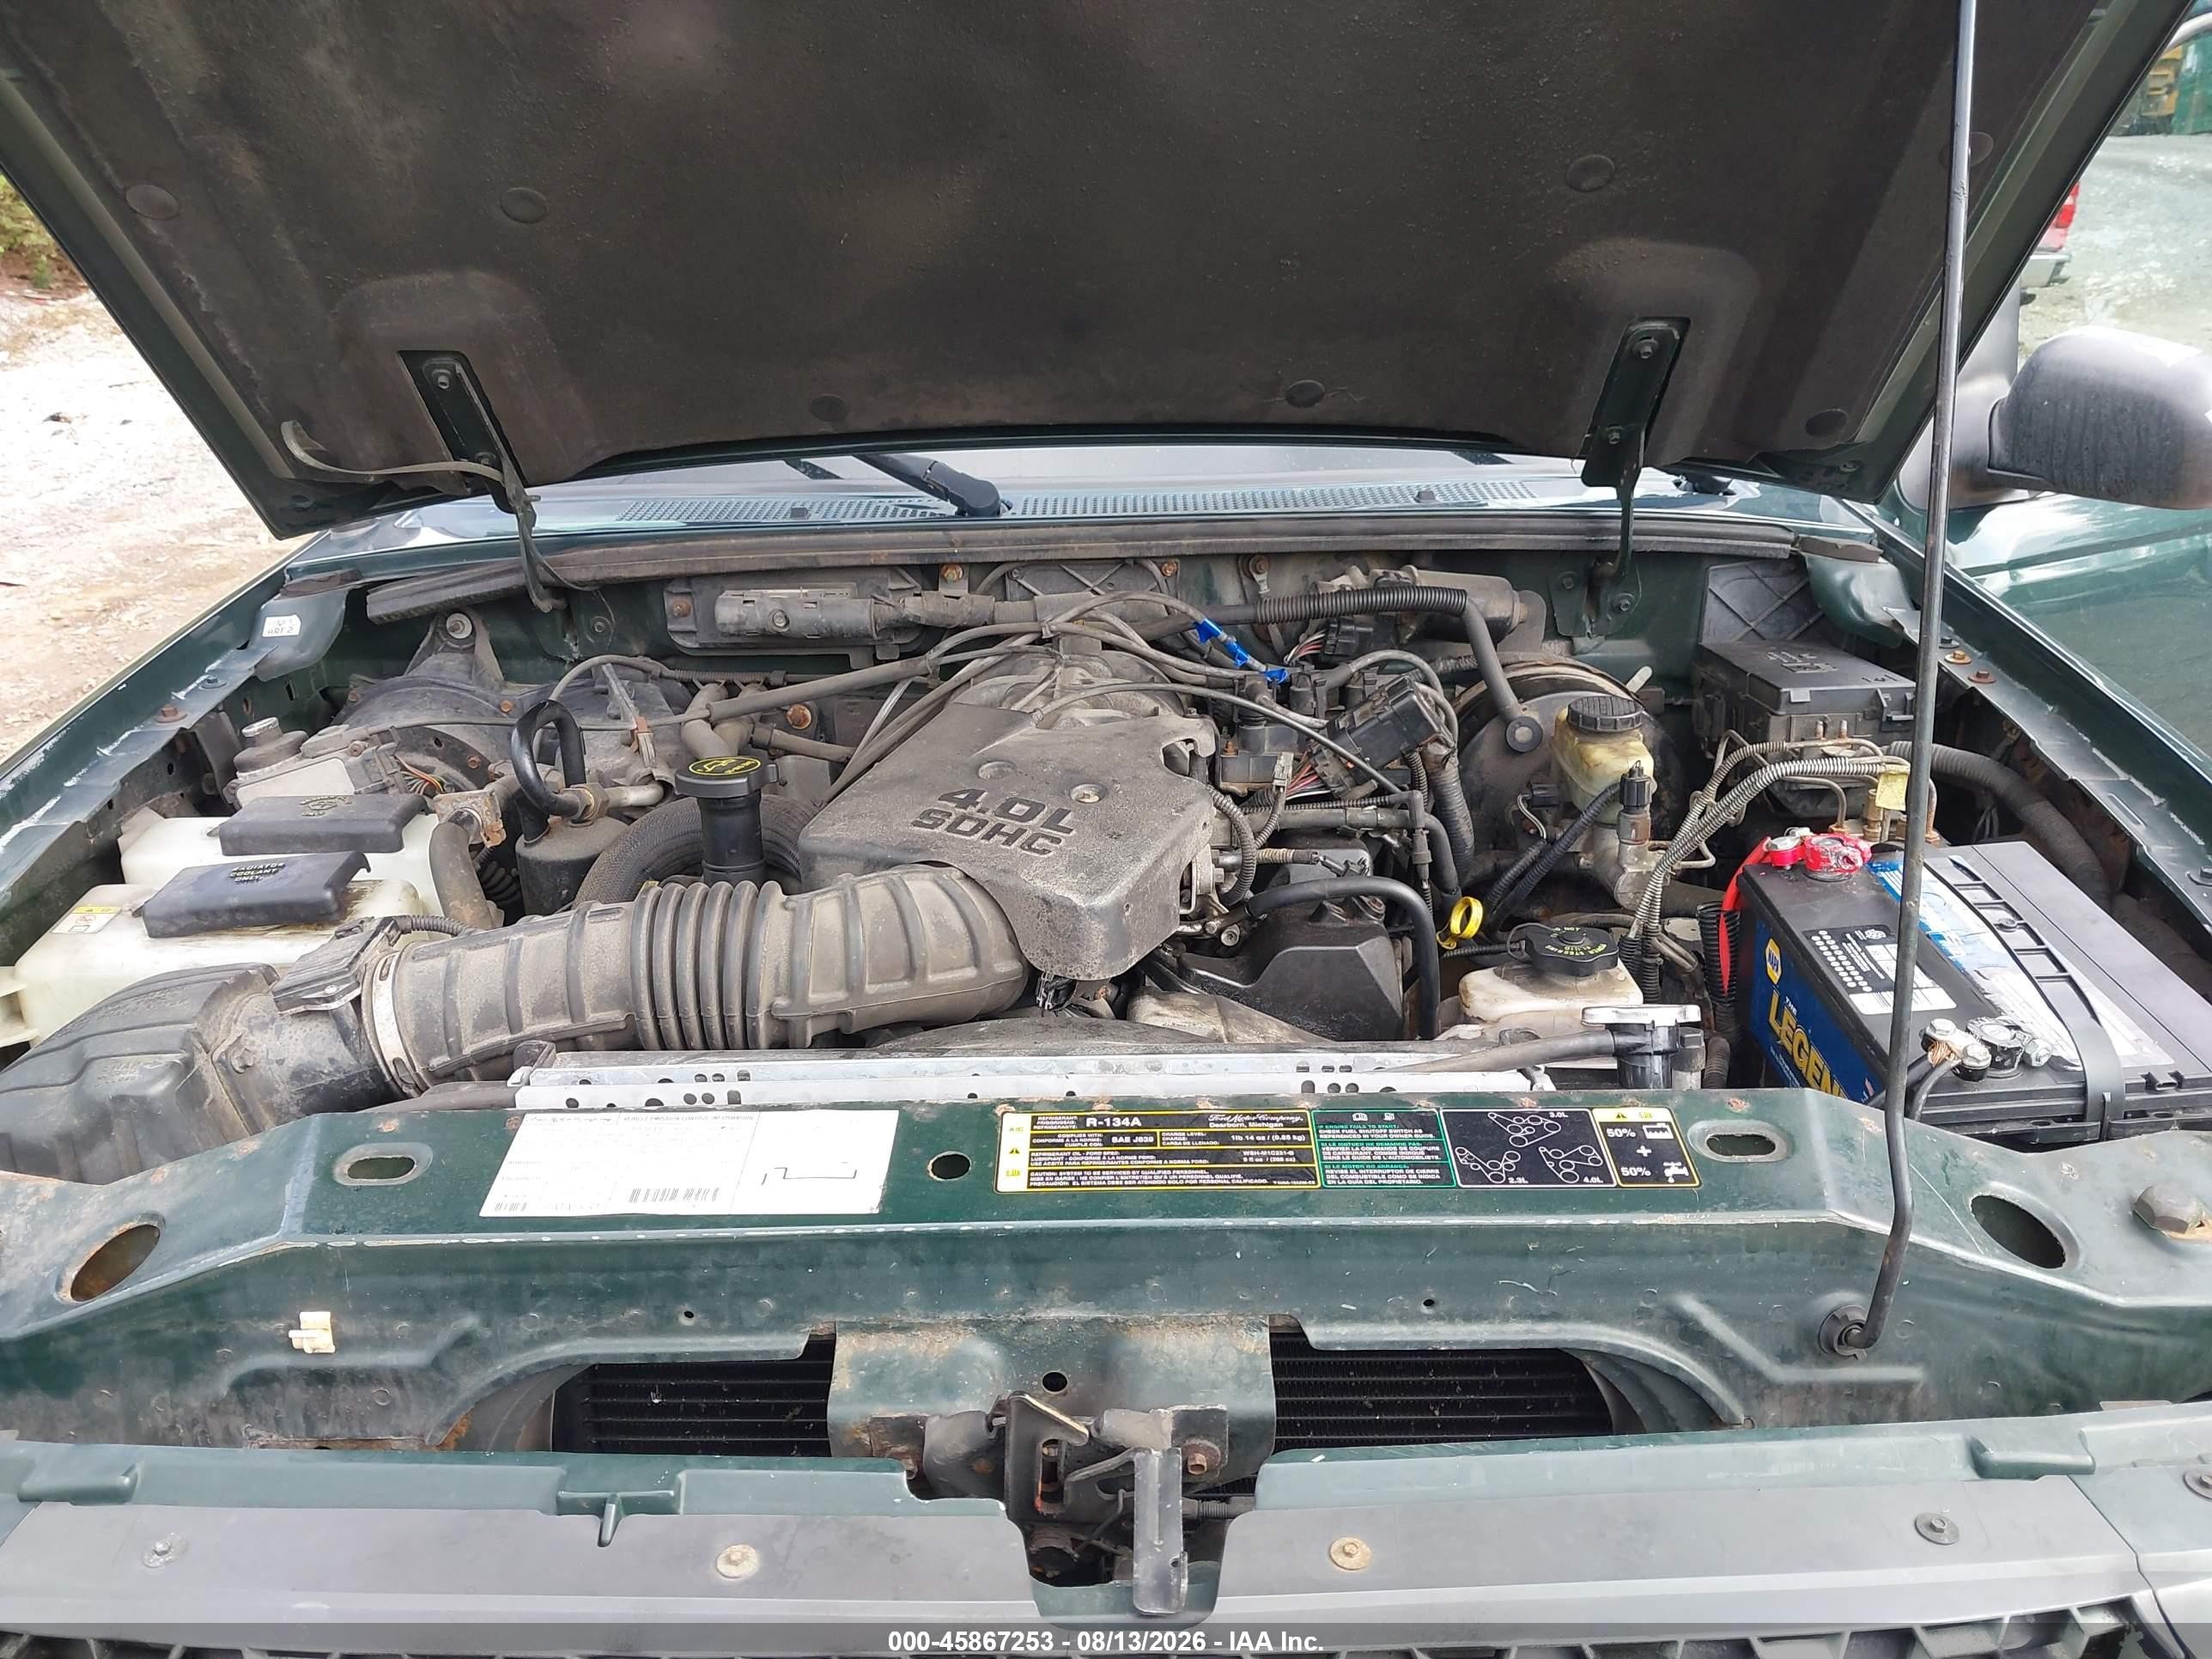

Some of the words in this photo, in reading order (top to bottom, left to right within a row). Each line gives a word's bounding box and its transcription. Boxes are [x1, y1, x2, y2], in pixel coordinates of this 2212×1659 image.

[939, 787, 1075, 835] 4.0L
[229, 869, 279, 878] COOLANT
[1785, 996, 1798, 1017] THE
[1768, 988, 1848, 1100] LEGEN
[1085, 1117, 1142, 1127] R-134A
[1606, 1127, 1637, 1138] 50%
[1620, 1166, 1650, 1176] 50%
